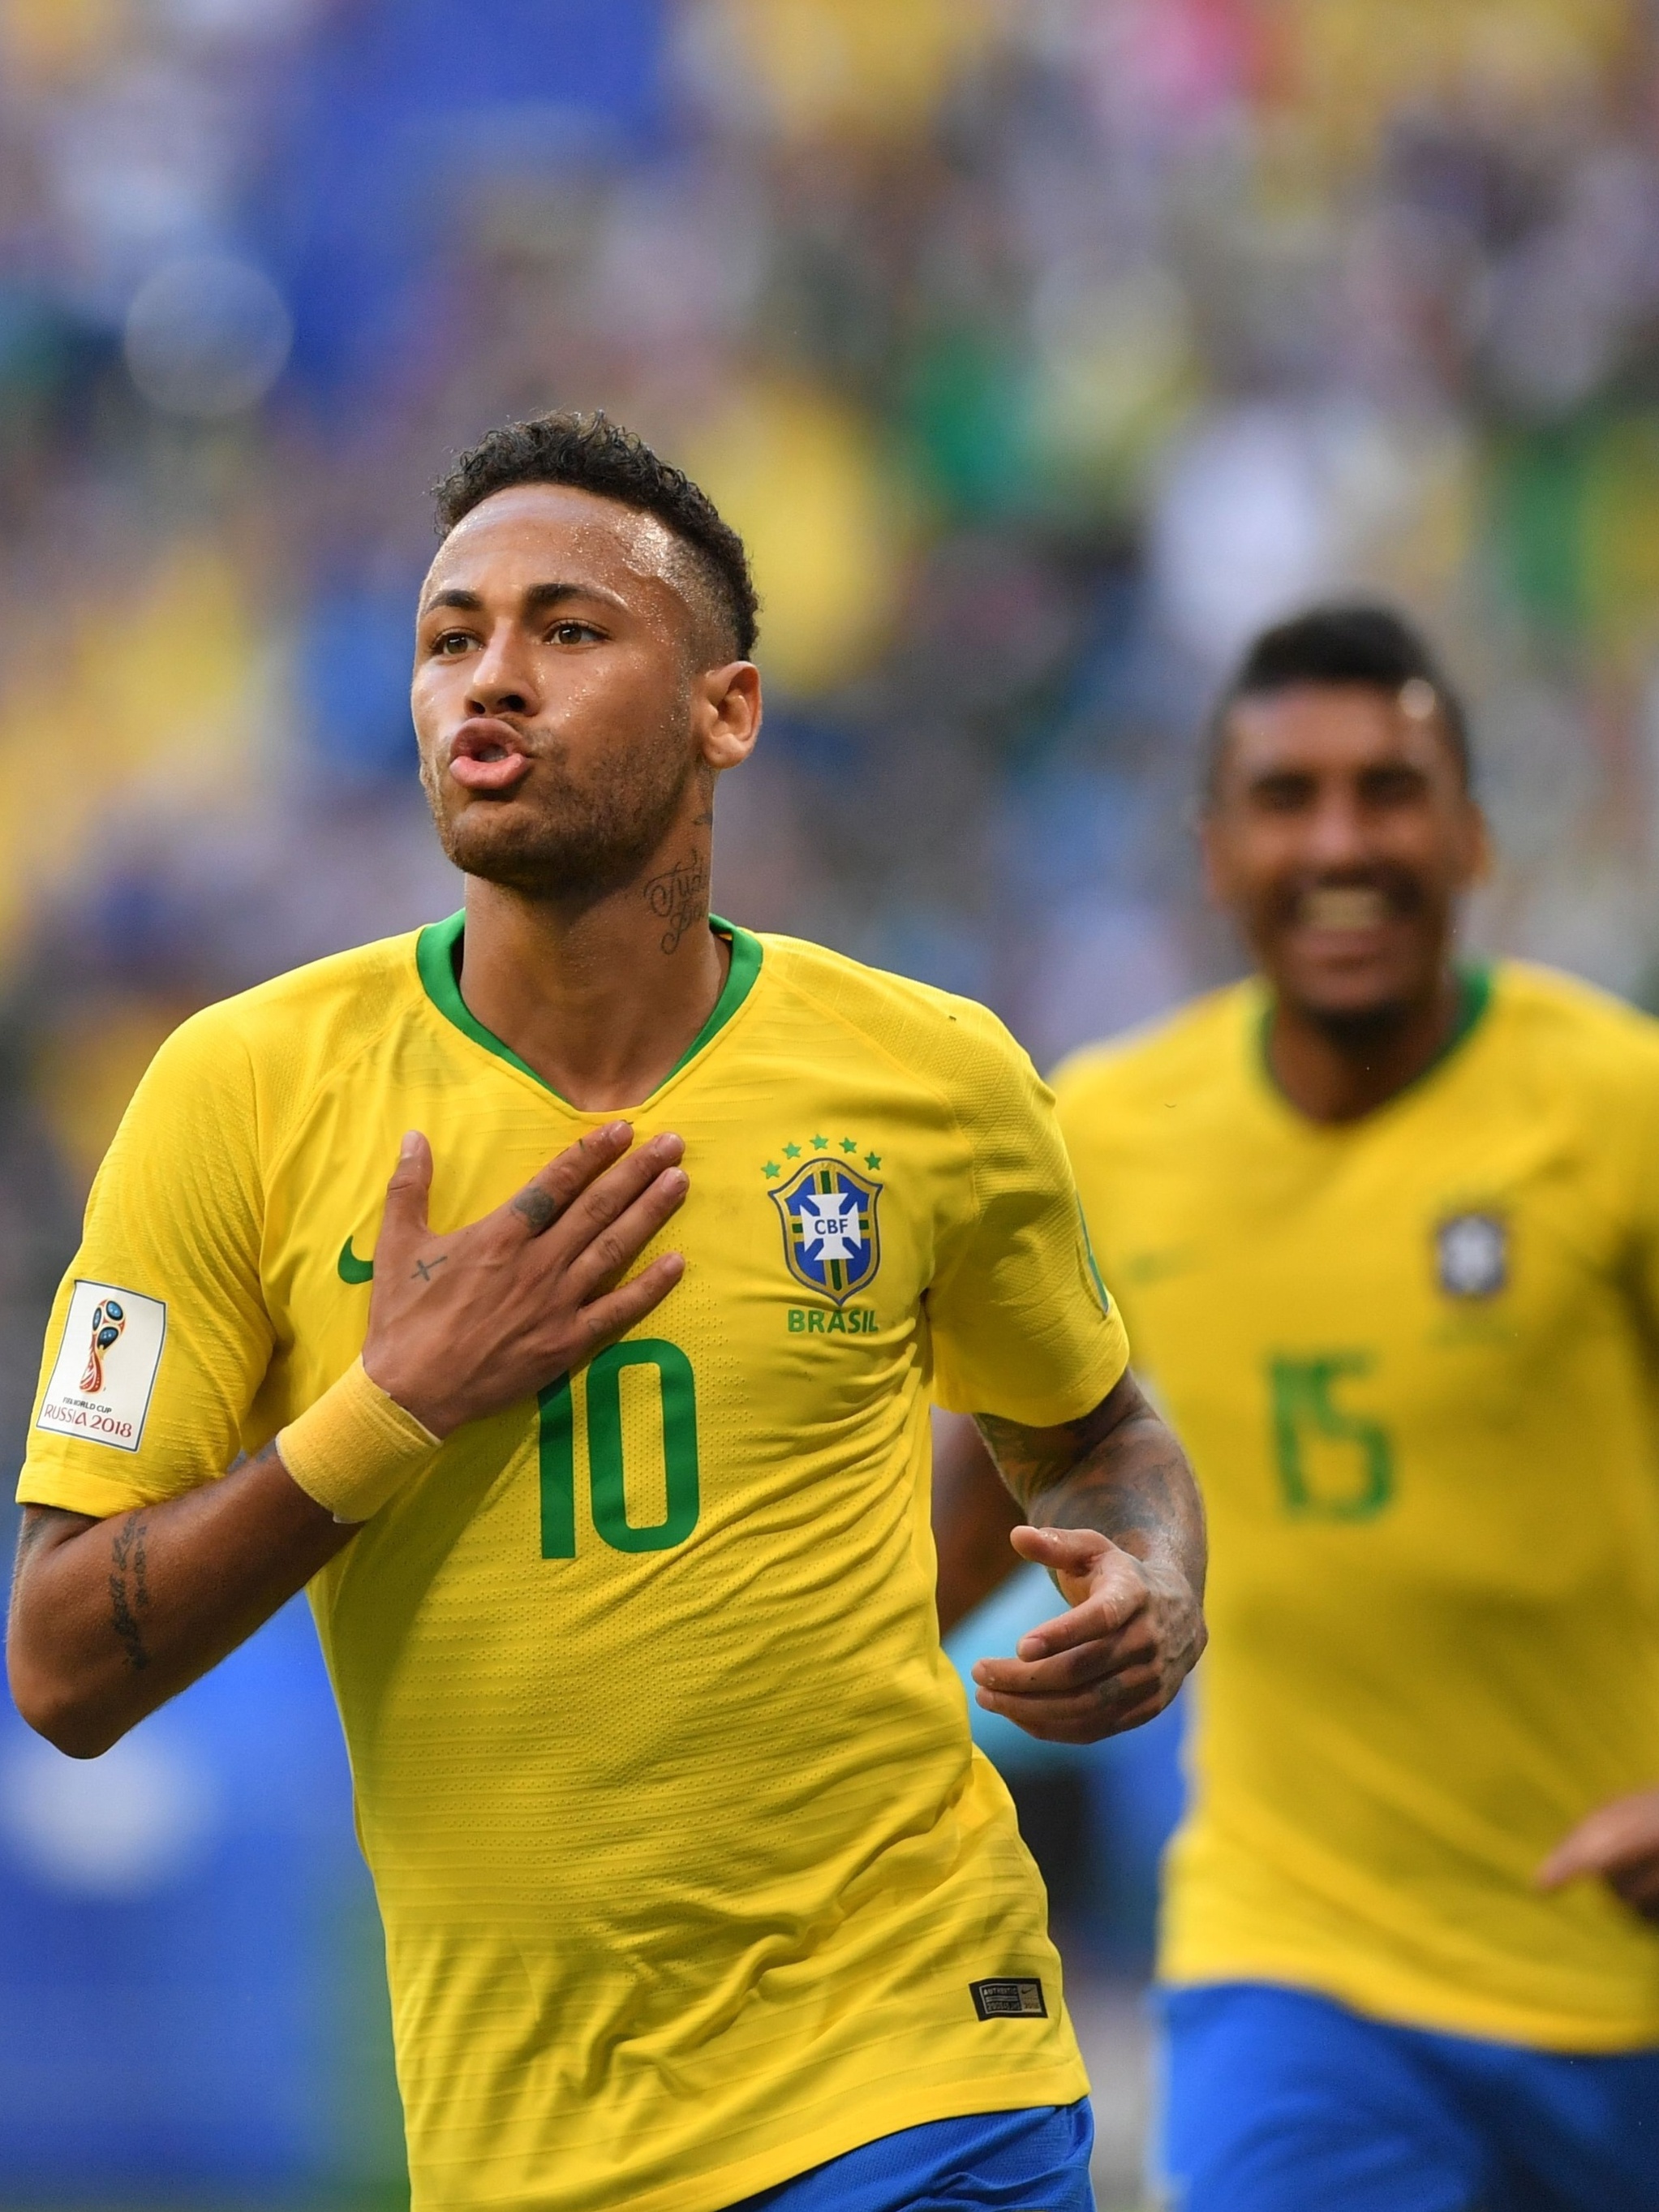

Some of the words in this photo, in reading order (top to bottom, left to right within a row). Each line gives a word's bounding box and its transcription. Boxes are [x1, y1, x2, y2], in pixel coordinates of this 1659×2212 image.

[814, 1218, 849, 1235] CBF
[788, 1309, 879, 1334] BRASIL
[44, 1403, 88, 1427] RUSSIA
[89, 1414, 132, 1438] 2018
[73, 1399, 96, 1410] WORLD
[97, 1405, 113, 1414] CUP
[537, 1337, 700, 1560] 10
[1269, 1352, 1396, 1522] 15
